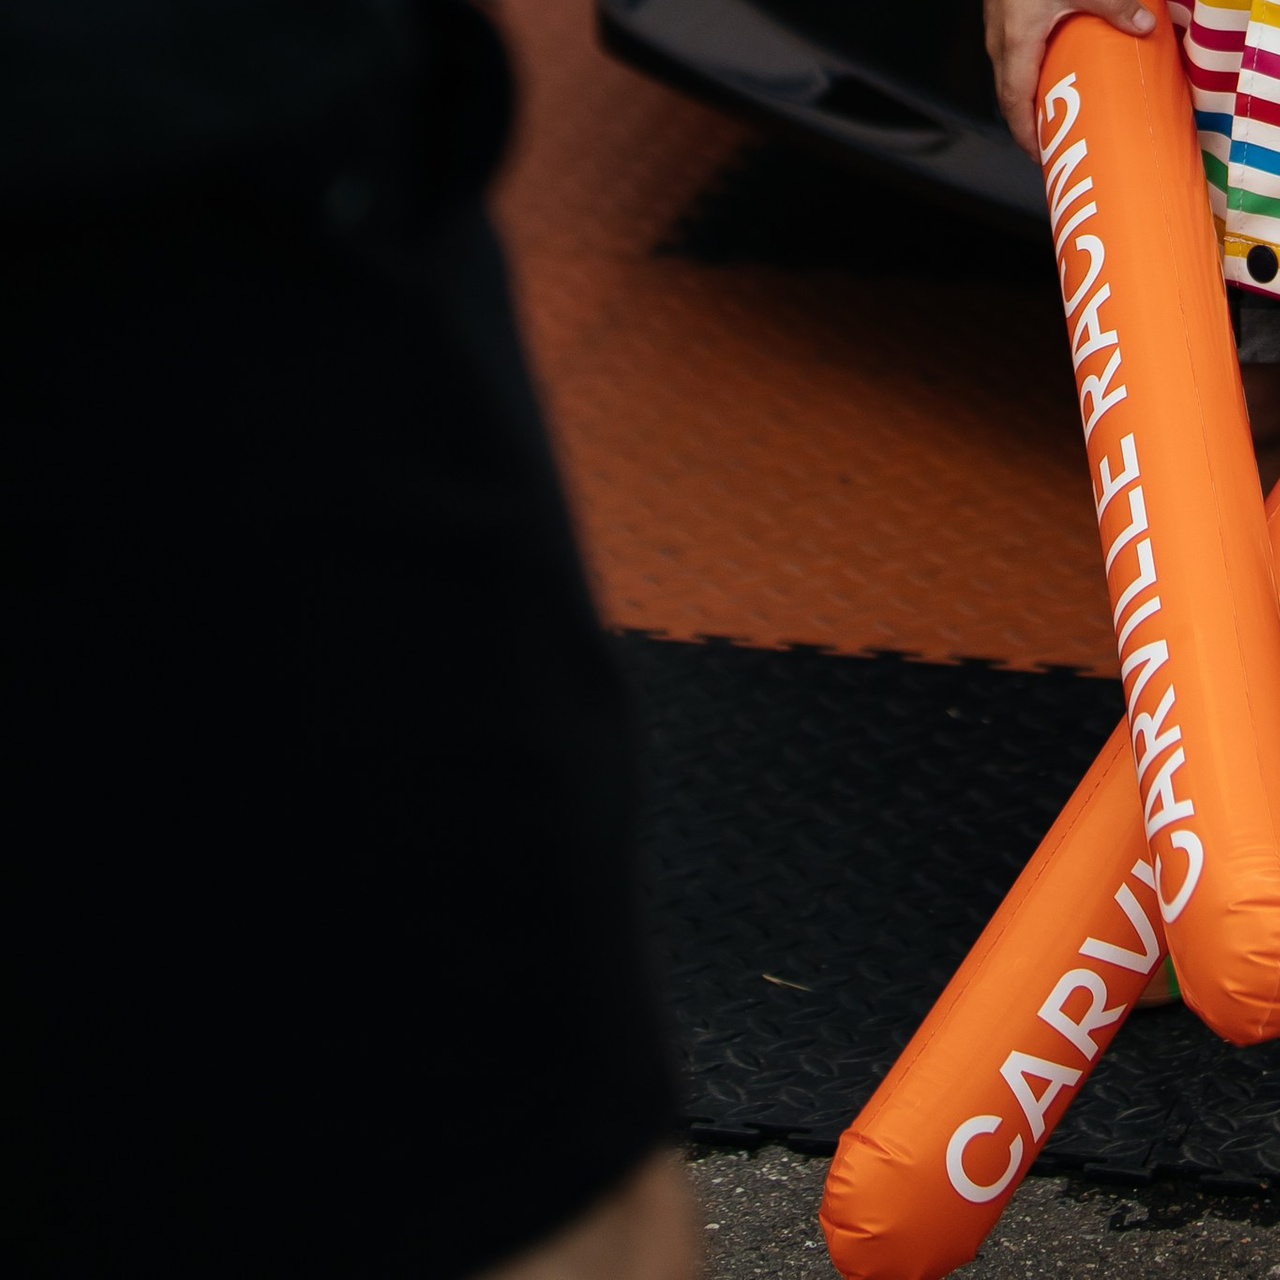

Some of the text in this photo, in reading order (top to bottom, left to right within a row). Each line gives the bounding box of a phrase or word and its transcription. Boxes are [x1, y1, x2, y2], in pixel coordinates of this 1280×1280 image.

[1038, 72, 1204, 924] CARVILLE RACING
[946, 858, 1161, 1203] CARV
